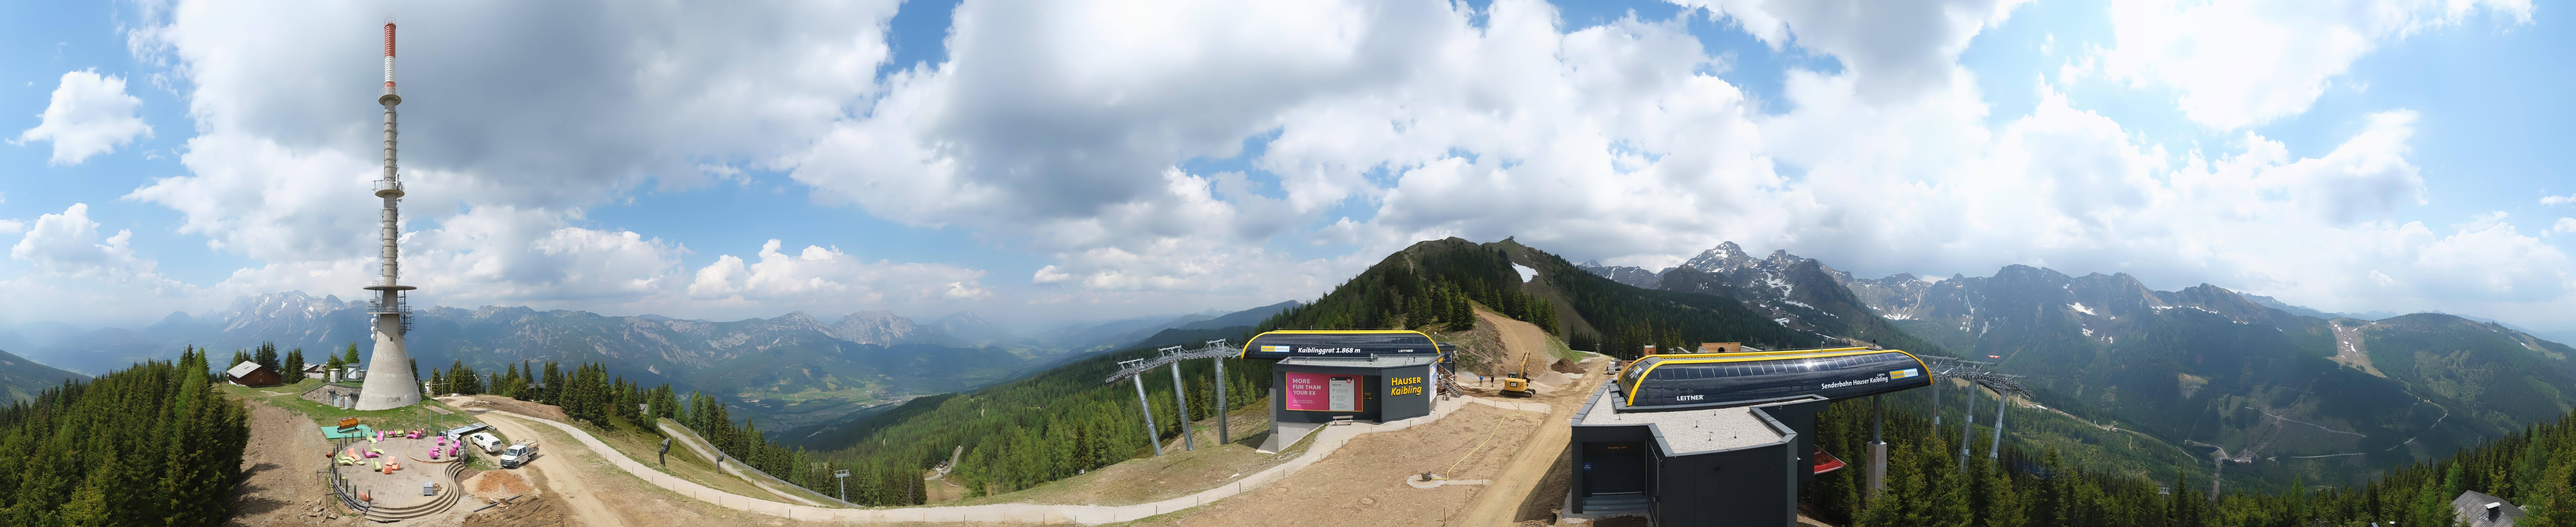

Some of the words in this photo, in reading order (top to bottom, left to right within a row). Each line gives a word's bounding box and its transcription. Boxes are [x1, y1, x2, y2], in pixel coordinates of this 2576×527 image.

[1391, 377, 1421, 386] HAUSER
[1821, 380, 1852, 389] Senderbahn
[1391, 386, 1422, 396] Kaibling
